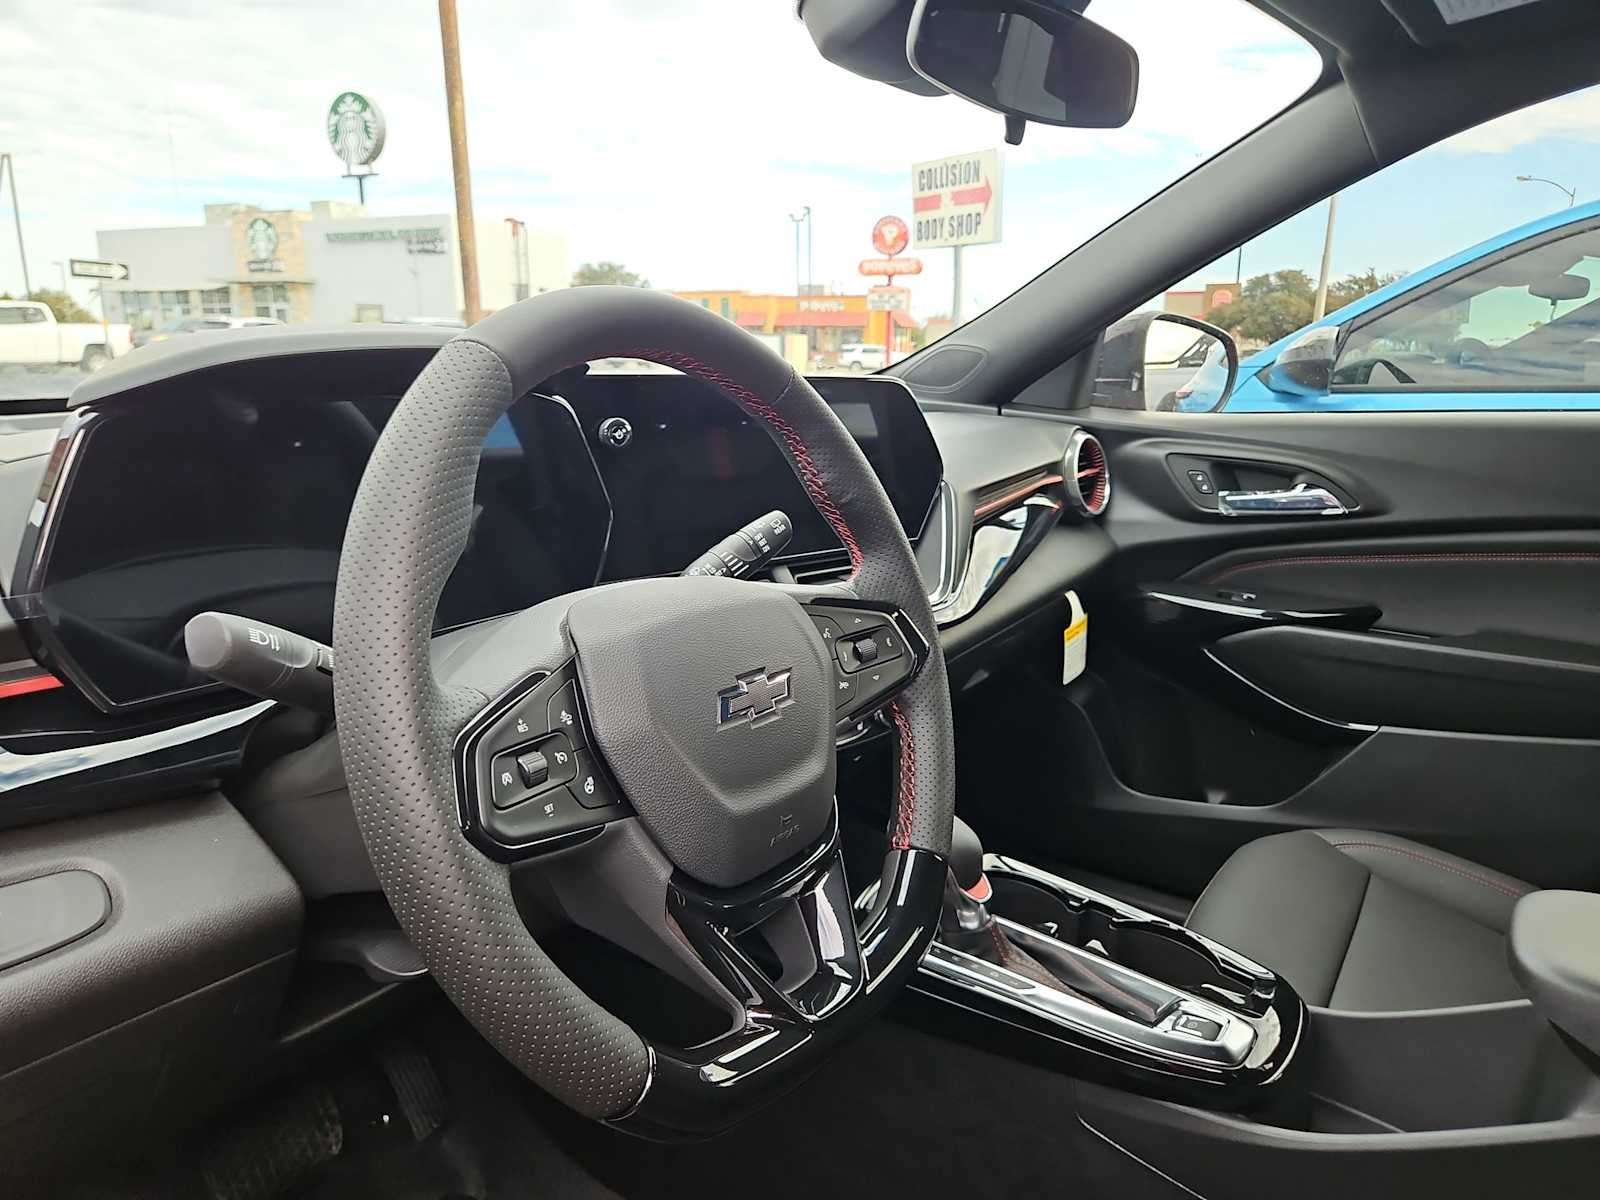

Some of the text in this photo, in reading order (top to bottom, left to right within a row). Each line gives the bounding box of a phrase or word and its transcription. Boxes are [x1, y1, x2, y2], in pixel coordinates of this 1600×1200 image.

[918, 160, 981, 192] COLLISION
[916, 212, 982, 242] BODY SHOP
